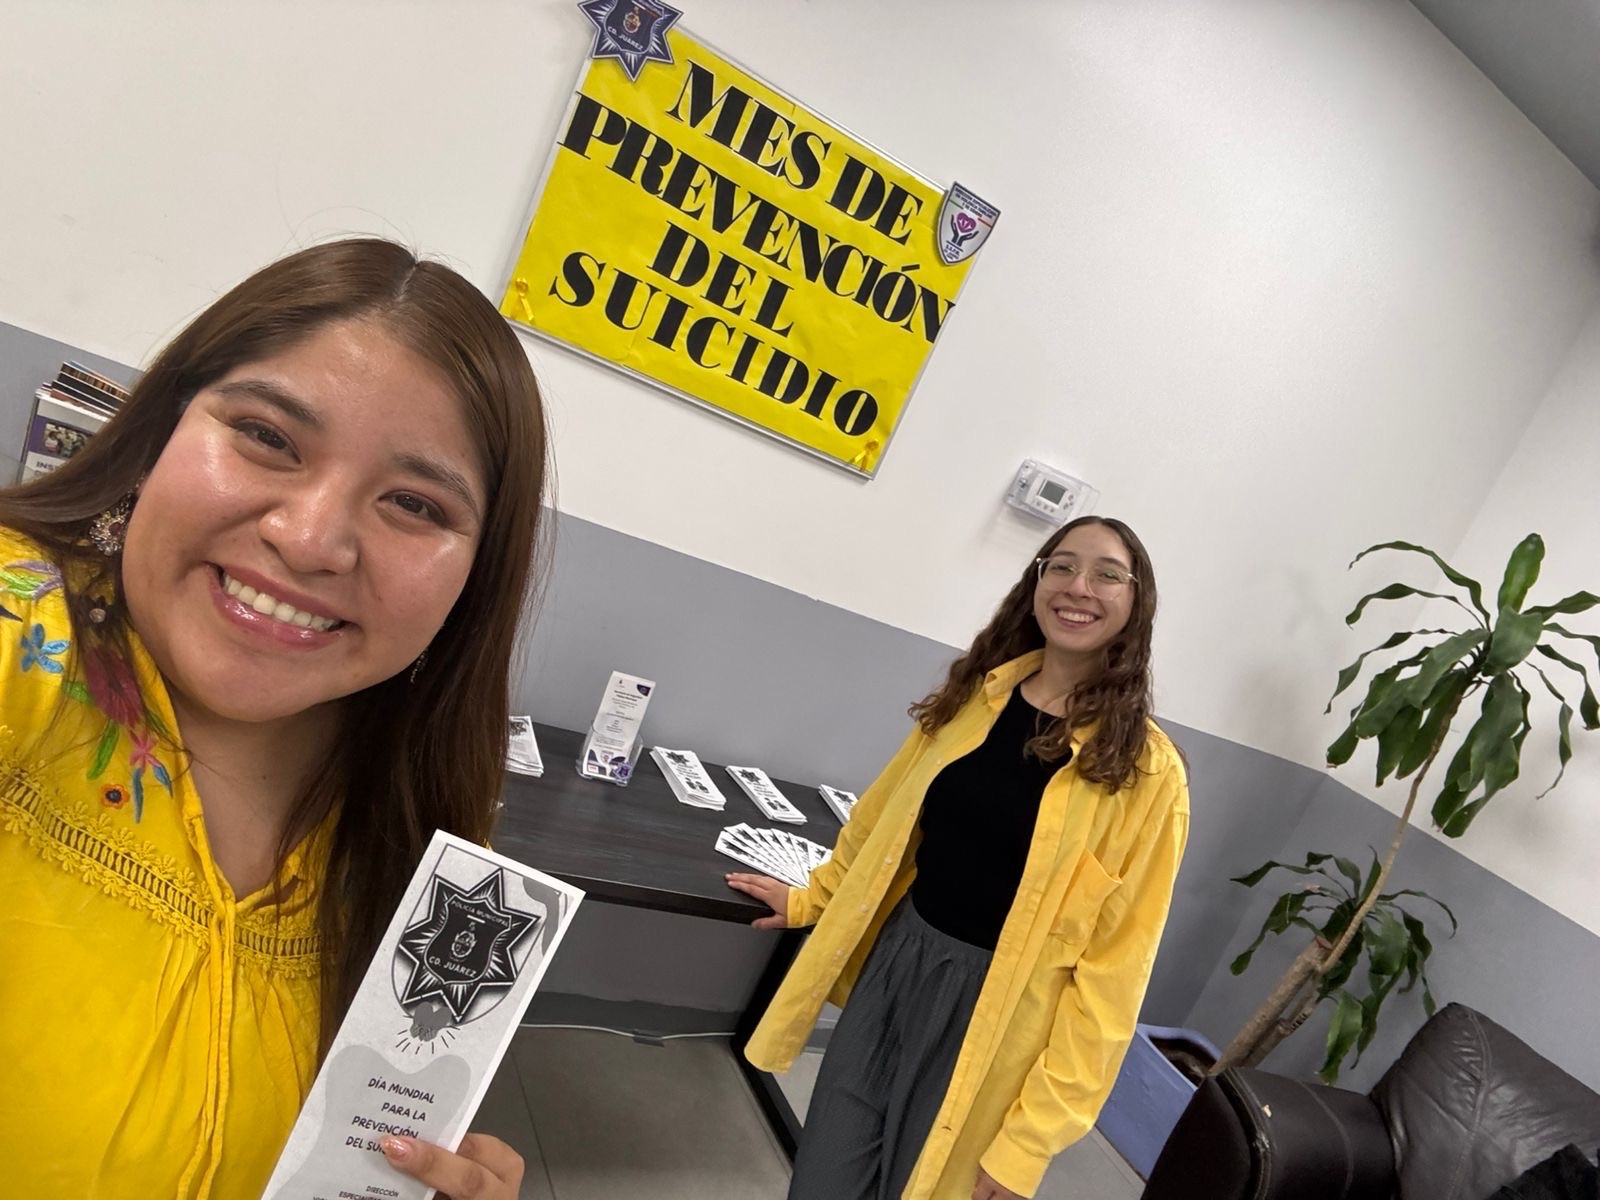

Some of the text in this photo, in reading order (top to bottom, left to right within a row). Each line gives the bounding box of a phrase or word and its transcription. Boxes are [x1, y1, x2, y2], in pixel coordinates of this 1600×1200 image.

[665, 59, 923, 246] MES DE
[557, 91, 956, 344] PREVENCIÓN
[646, 220, 795, 338] DEL
[549, 251, 879, 436] SUICIDIO
[368, 1076, 435, 1104] DÍA MUNDIAL
[380, 1102, 426, 1122] PARA LA
[345, 1136, 364, 1149] DEL
[351, 1115, 419, 1139] PREVENCIÓN
